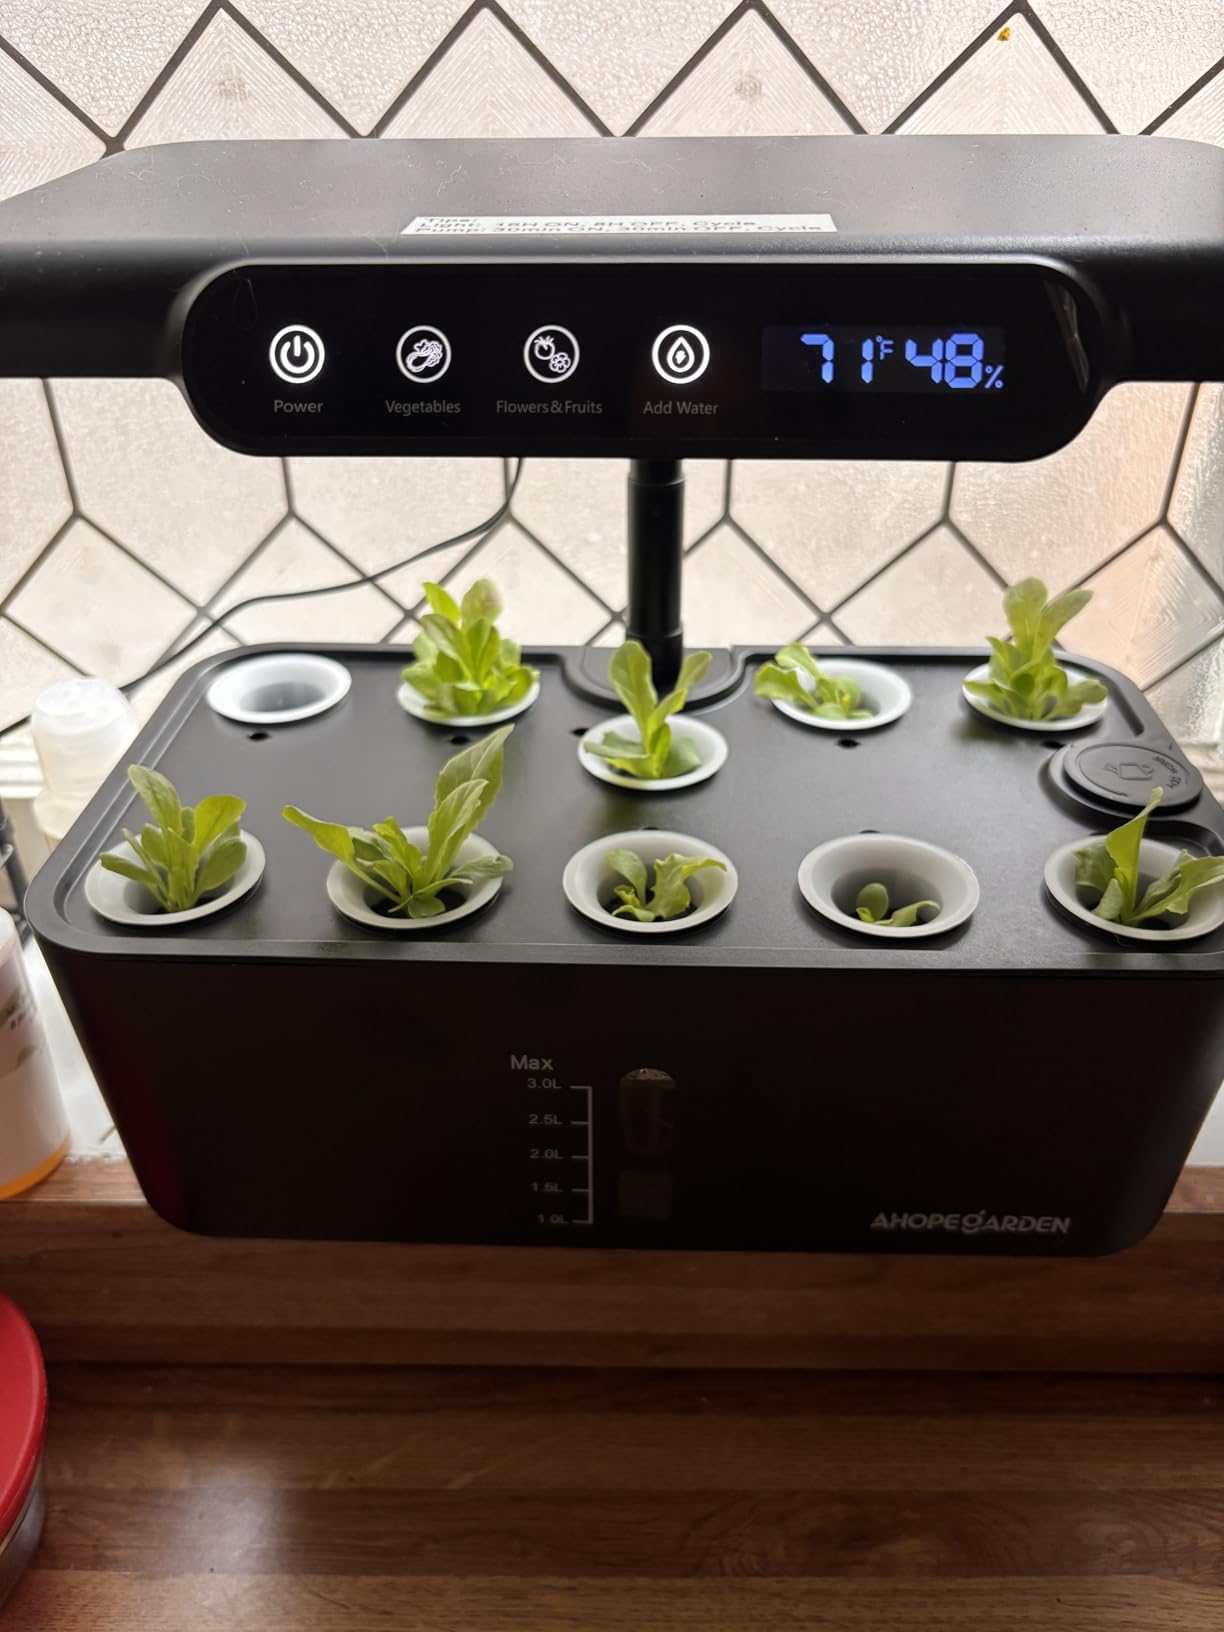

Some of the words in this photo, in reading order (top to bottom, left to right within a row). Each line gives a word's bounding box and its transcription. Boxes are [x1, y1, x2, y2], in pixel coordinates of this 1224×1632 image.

[274, 400, 324, 414] Power
[385, 399, 461, 416] Vegetables
[496, 400, 603, 415] Flowers&Fruits
[643, 401, 672, 415] Add
[674, 401, 719, 415] Water
[510, 1054, 554, 1071] Max
[527, 1078, 562, 1089] 3.0L
[528, 1113, 563, 1125] 2.5L
[529, 1148, 564, 1160] 2.0L
[531, 1181, 564, 1193] 1.5L
[536, 1213, 569, 1225] 1.0L
